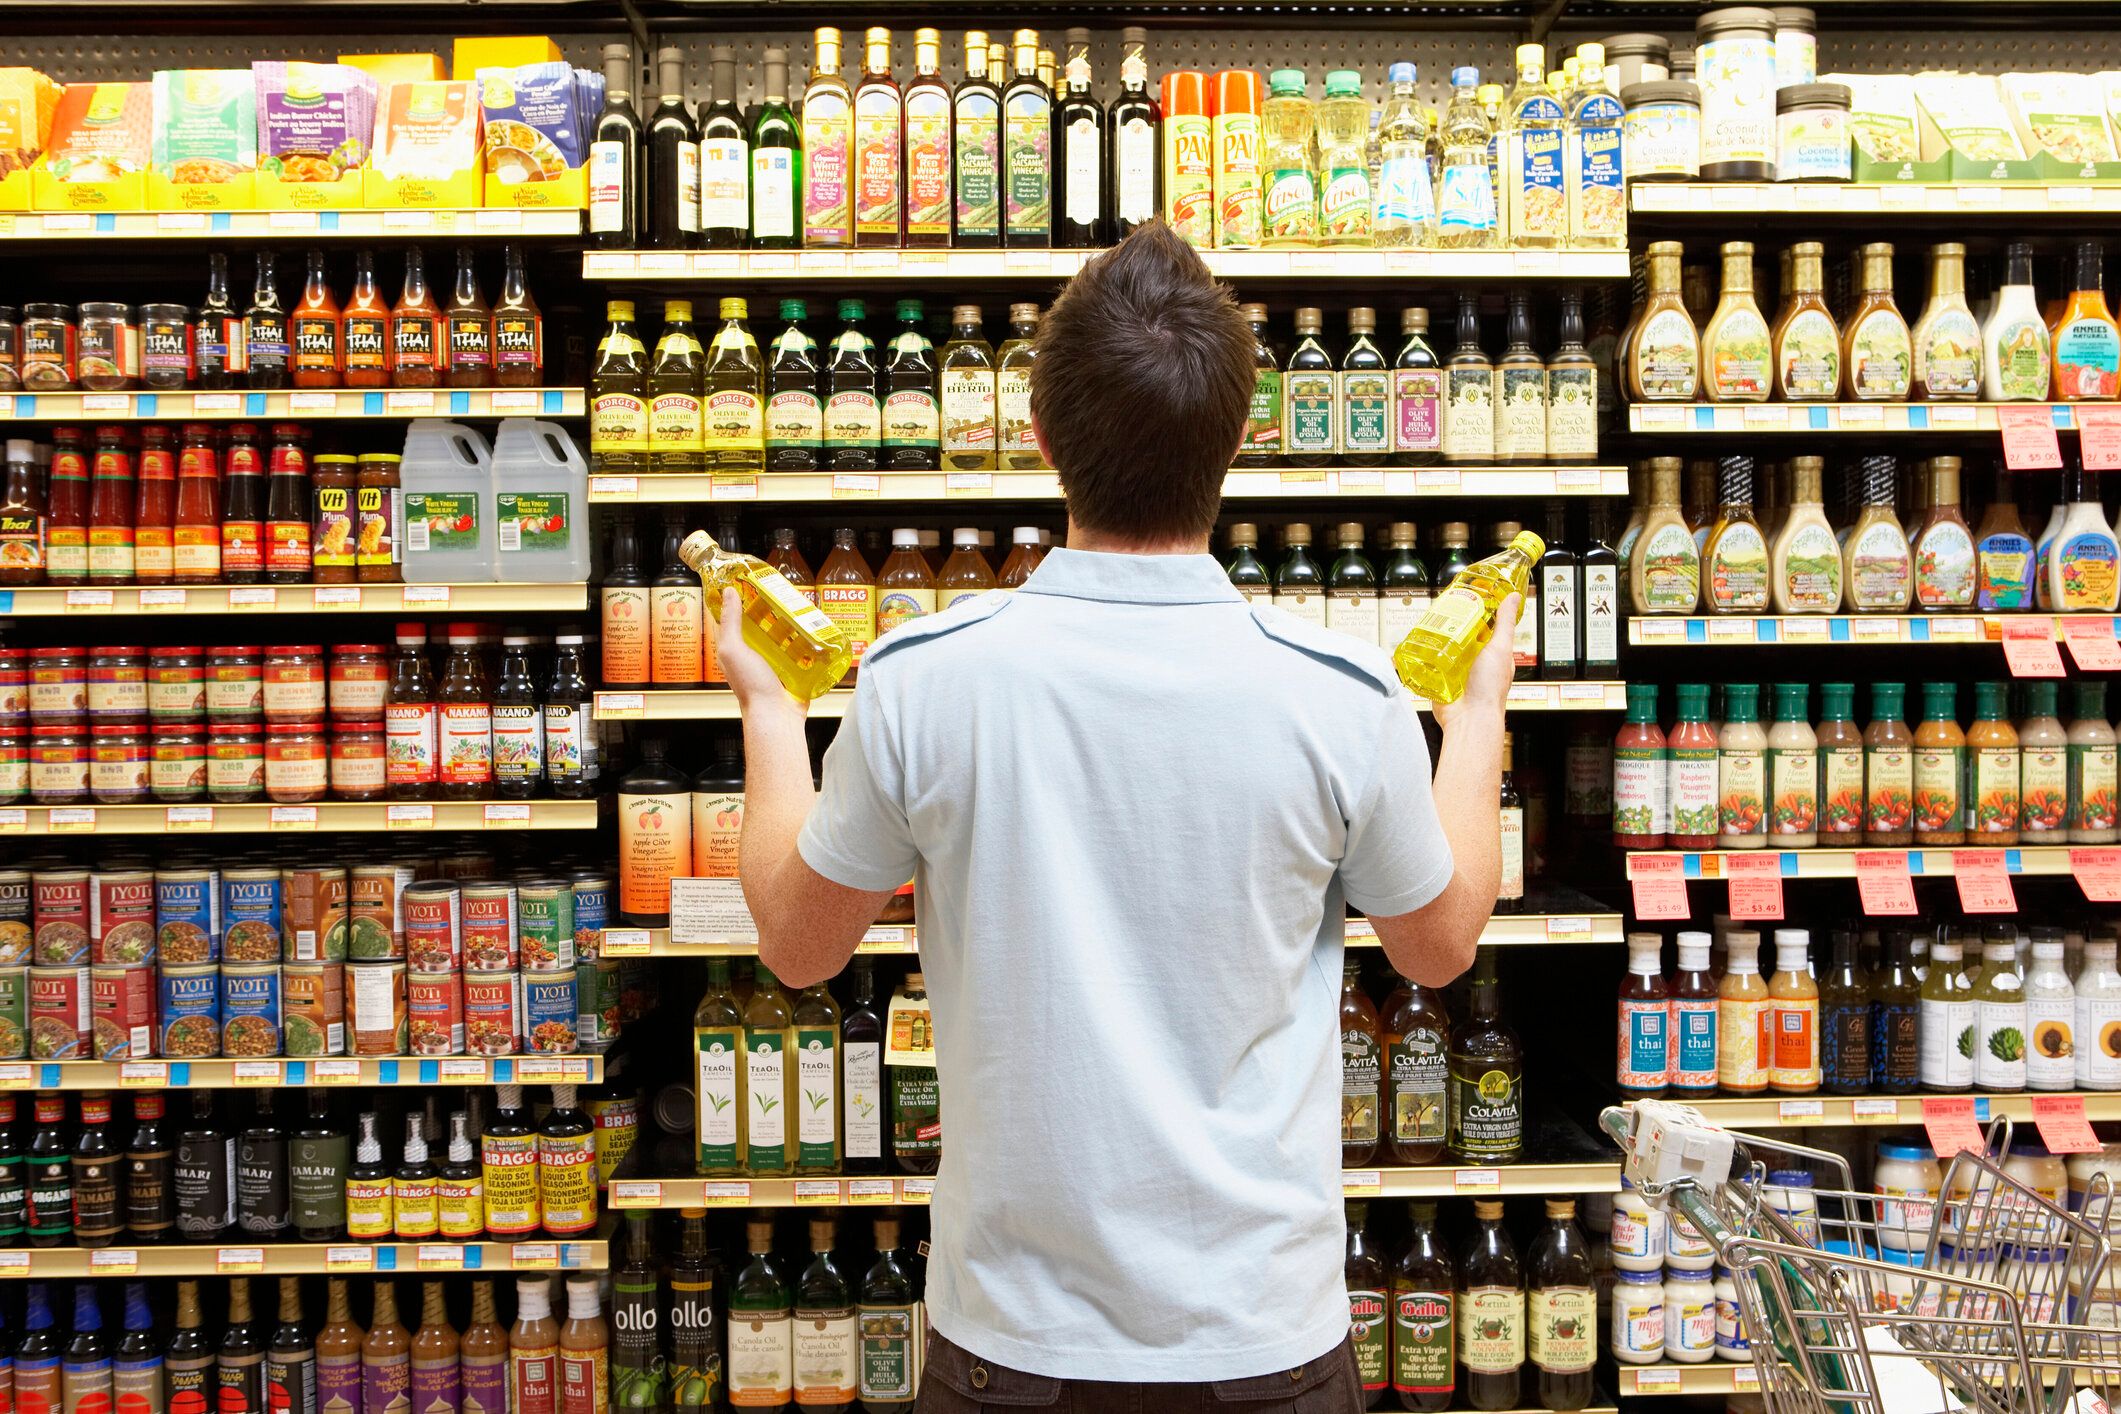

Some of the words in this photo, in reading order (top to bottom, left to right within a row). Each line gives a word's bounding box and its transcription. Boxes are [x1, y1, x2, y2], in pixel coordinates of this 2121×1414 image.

[270, 112, 292, 120] Indian
[293, 112, 313, 120] Butter
[314, 112, 342, 120] Chicken
[962, 167, 992, 176] VINEGAR
[1013, 167, 1042, 175] VINEGAR
[297, 334, 333, 349] THAI
[347, 334, 382, 349] THAI
[395, 334, 430, 348] THAI
[452, 333, 488, 347] THAI
[598, 397, 637, 409] BORGES
[656, 397, 694, 409] BORGES
[712, 393, 751, 406] BORGES
[775, 394, 812, 406] BORGES
[322, 512, 346, 521] Plum
[360, 512, 379, 521] Plum
[1, 518, 32, 529] Thai
[824, 590, 867, 600] BRAGG
[606, 633, 626, 641] Vinegar
[629, 799, 647, 809] Omega
[648, 798, 673, 809] Nutrition
[633, 838, 651, 847] Apple
[653, 838, 671, 846] Cider
[711, 837, 729, 846] Apple
[632, 847, 657, 856] Vinegar
[710, 846, 735, 854] Vinegar
[1751, 905, 1777, 913] $3.49
[1638, 1039, 1662, 1050] thai
[1687, 1037, 1711, 1049] thai
[1781, 1034, 1805, 1047] thai
[484, 1151, 535, 1166] BRAGG
[541, 1151, 587, 1166] BRAGG
[292, 1166, 336, 1177] TAMARI
[488, 1171, 510, 1180] LIQUID
[512, 1171, 530, 1180] SOY
[488, 1178, 531, 1188] SEASONING
[397, 1187, 431, 1198] BRAGG
[491, 1197, 511, 1206] SOJA
[511, 1194, 537, 1205] LIQUIDE
[1400, 1301, 1447, 1317] Gallo
[615, 1303, 657, 1331] ollo
[671, 1301, 712, 1329] ollo
[764, 1336, 777, 1344] Oil
[761, 1344, 784, 1352] canola
[801, 1342, 826, 1350] Canola
[1400, 1345, 1419, 1354] Extra
[1420, 1345, 1447, 1355] Virgin
[1425, 1355, 1438, 1363] Oil
[1401, 1363, 1420, 1371] Huile
[1422, 1363, 1446, 1371] d'olive
[172, 1374, 204, 1386] TAMARI
[1423, 1371, 1444, 1380] vierge
[524, 1385, 549, 1396] thai
[565, 1386, 586, 1397] thai
